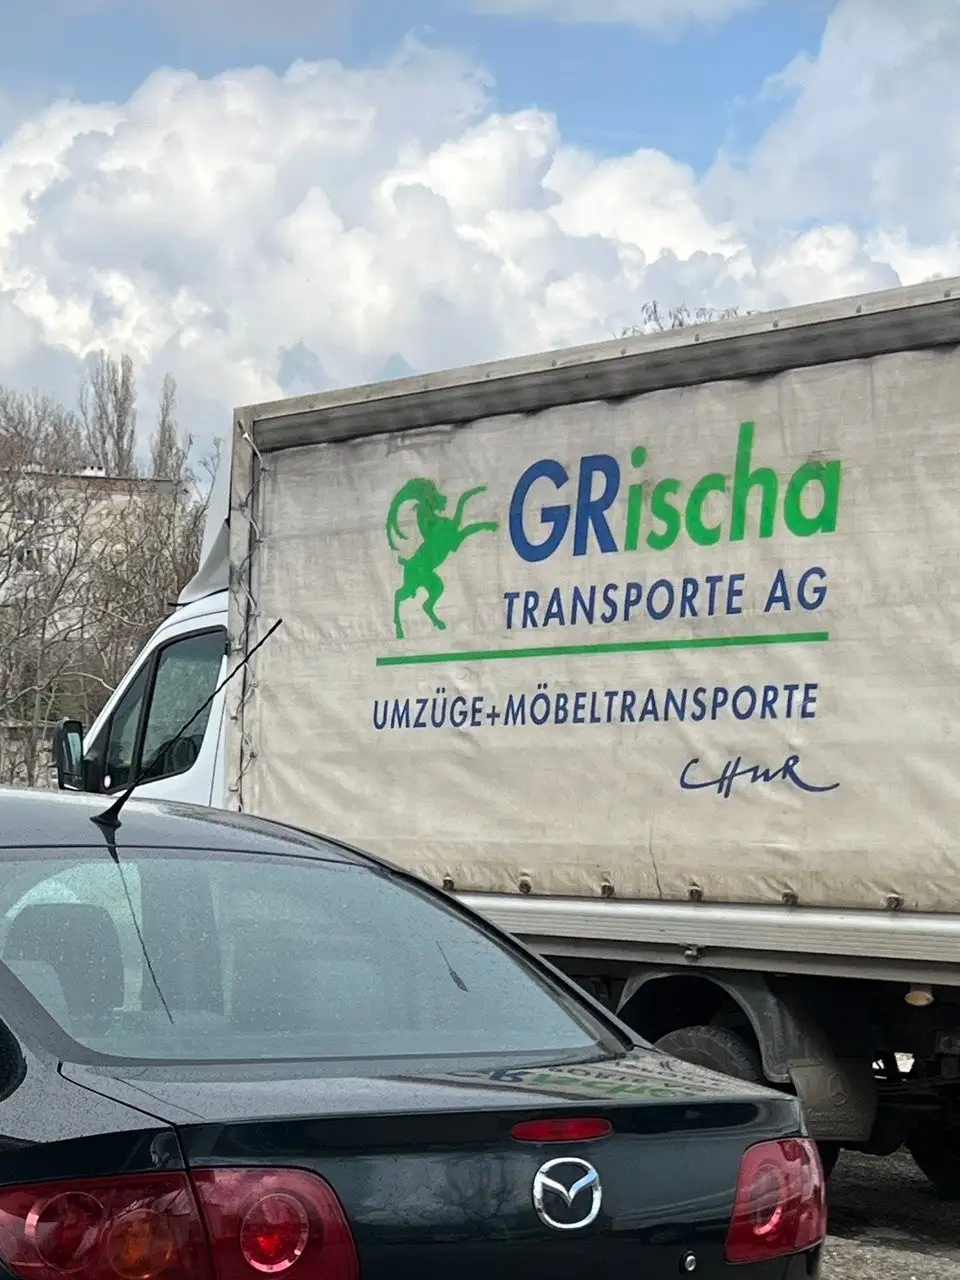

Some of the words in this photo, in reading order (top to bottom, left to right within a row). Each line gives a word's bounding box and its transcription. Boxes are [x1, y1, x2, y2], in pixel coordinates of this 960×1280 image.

[508, 421, 841, 563] GRischa
[503, 572, 745, 629] TRANSPORTE
[763, 566, 828, 613] AG
[372, 682, 819, 730] UMZÜGE+MÖBELTRANSPORTE
